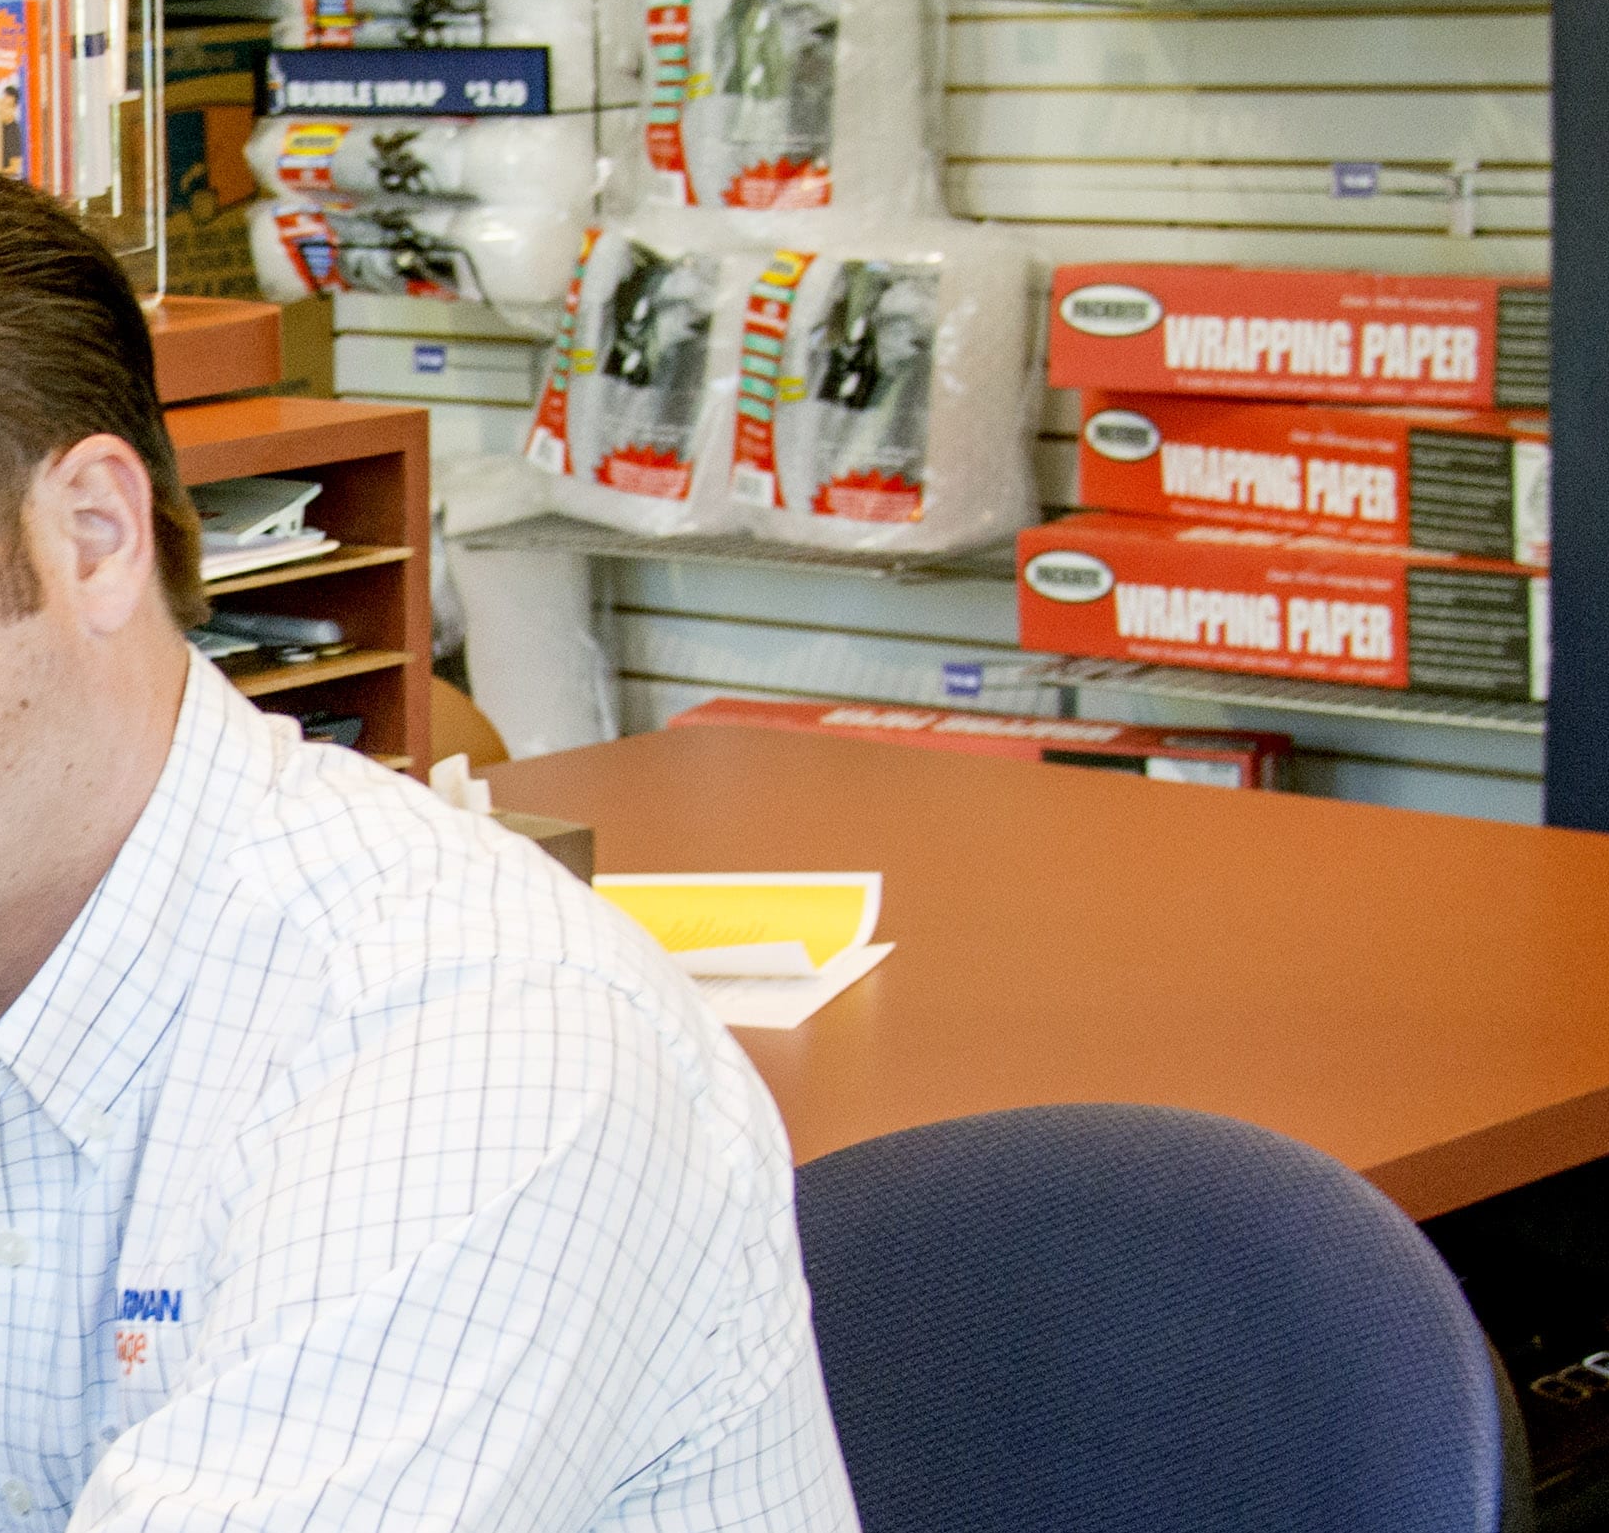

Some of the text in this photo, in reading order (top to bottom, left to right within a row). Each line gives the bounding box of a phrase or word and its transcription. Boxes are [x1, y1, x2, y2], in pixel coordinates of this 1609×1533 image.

[287, 81, 370, 107] BUBBLE
[374, 79, 447, 107] WRAP
[1163, 315, 1479, 383] WRAPPING PAPER
[1159, 443, 1397, 523] WRAPPING PAPER
[1114, 582, 1394, 662] WRAPPING PAPER
